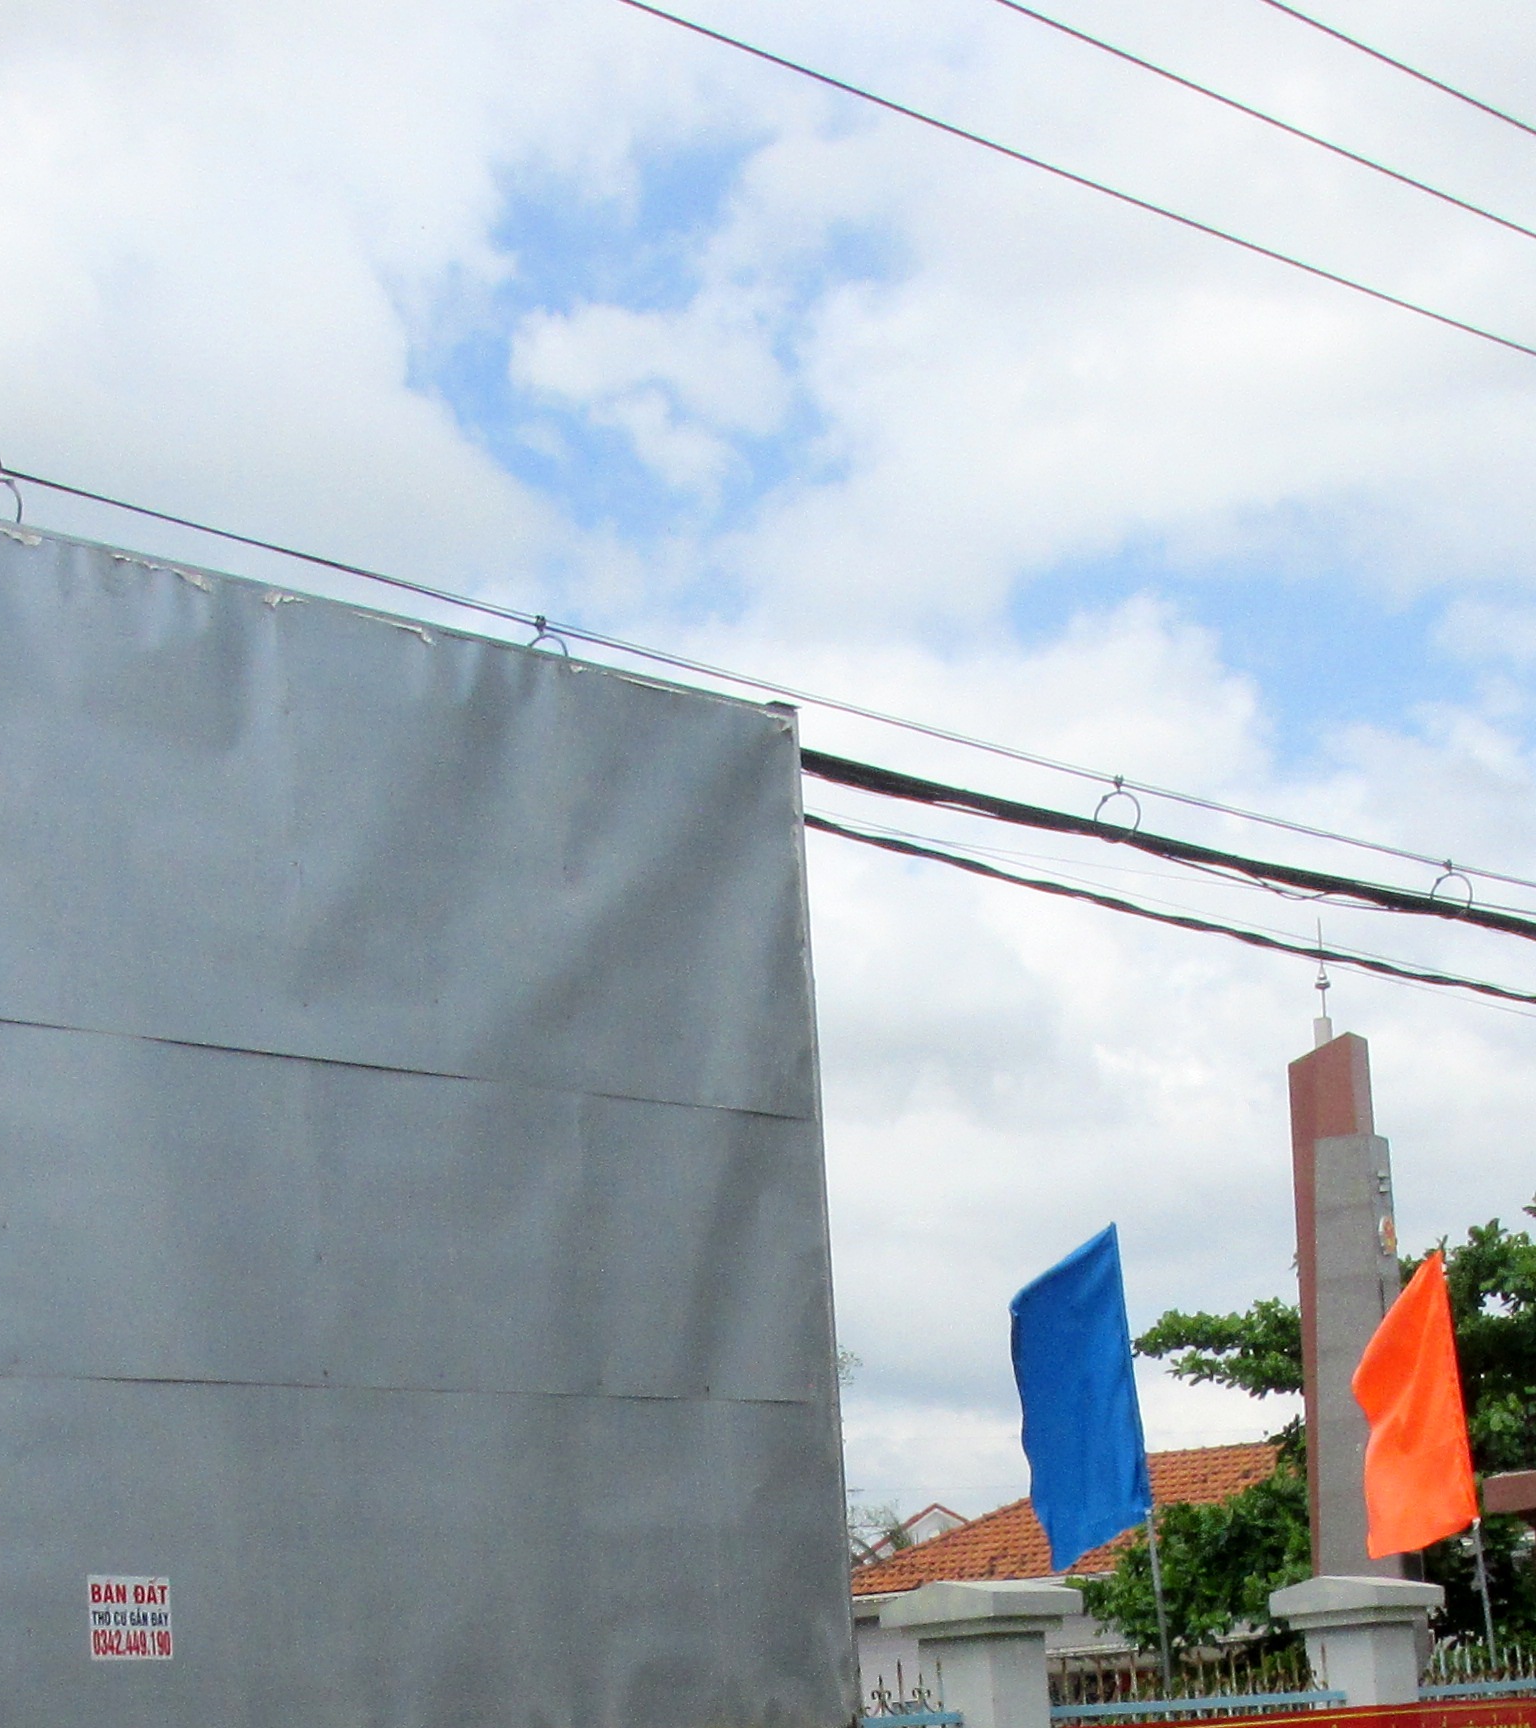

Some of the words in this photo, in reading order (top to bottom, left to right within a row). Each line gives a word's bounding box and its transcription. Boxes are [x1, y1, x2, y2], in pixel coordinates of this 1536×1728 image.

[90, 1579, 127, 1604] BÁN
[133, 1578, 168, 1604] ĐẤT
[93, 1630, 171, 1656] 0342.449.190
